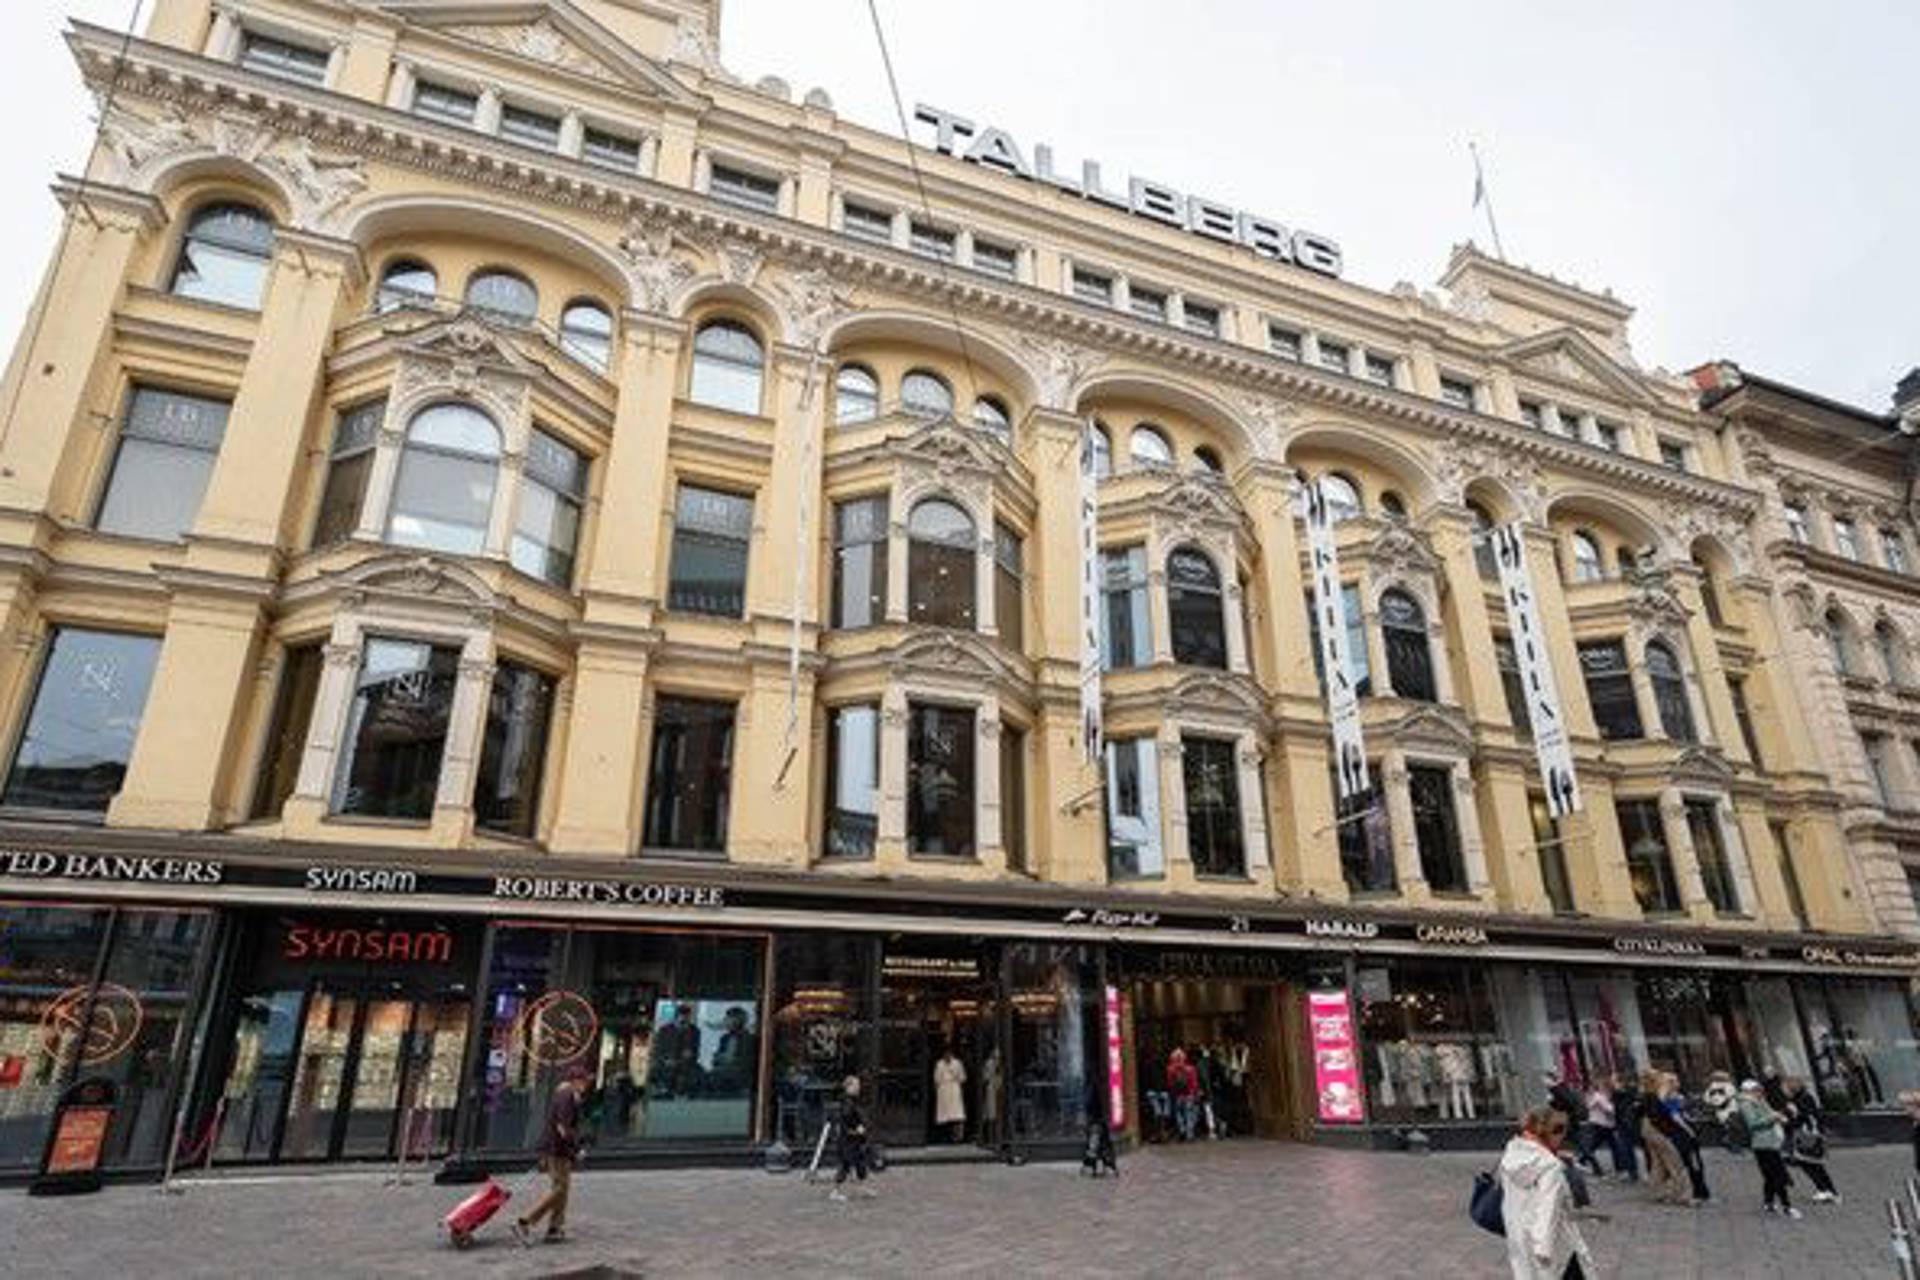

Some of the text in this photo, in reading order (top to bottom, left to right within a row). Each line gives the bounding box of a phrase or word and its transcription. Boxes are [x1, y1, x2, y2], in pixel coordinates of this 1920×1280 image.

[914, 103, 1344, 278] TALLBERG
[64, 854, 223, 882] BANKERS
[305, 867, 417, 892] SYNSAM
[494, 877, 725, 906] ROBERT'S COFFEE
[1305, 919, 1379, 937] HARALD
[286, 928, 452, 961] SYNSAM
